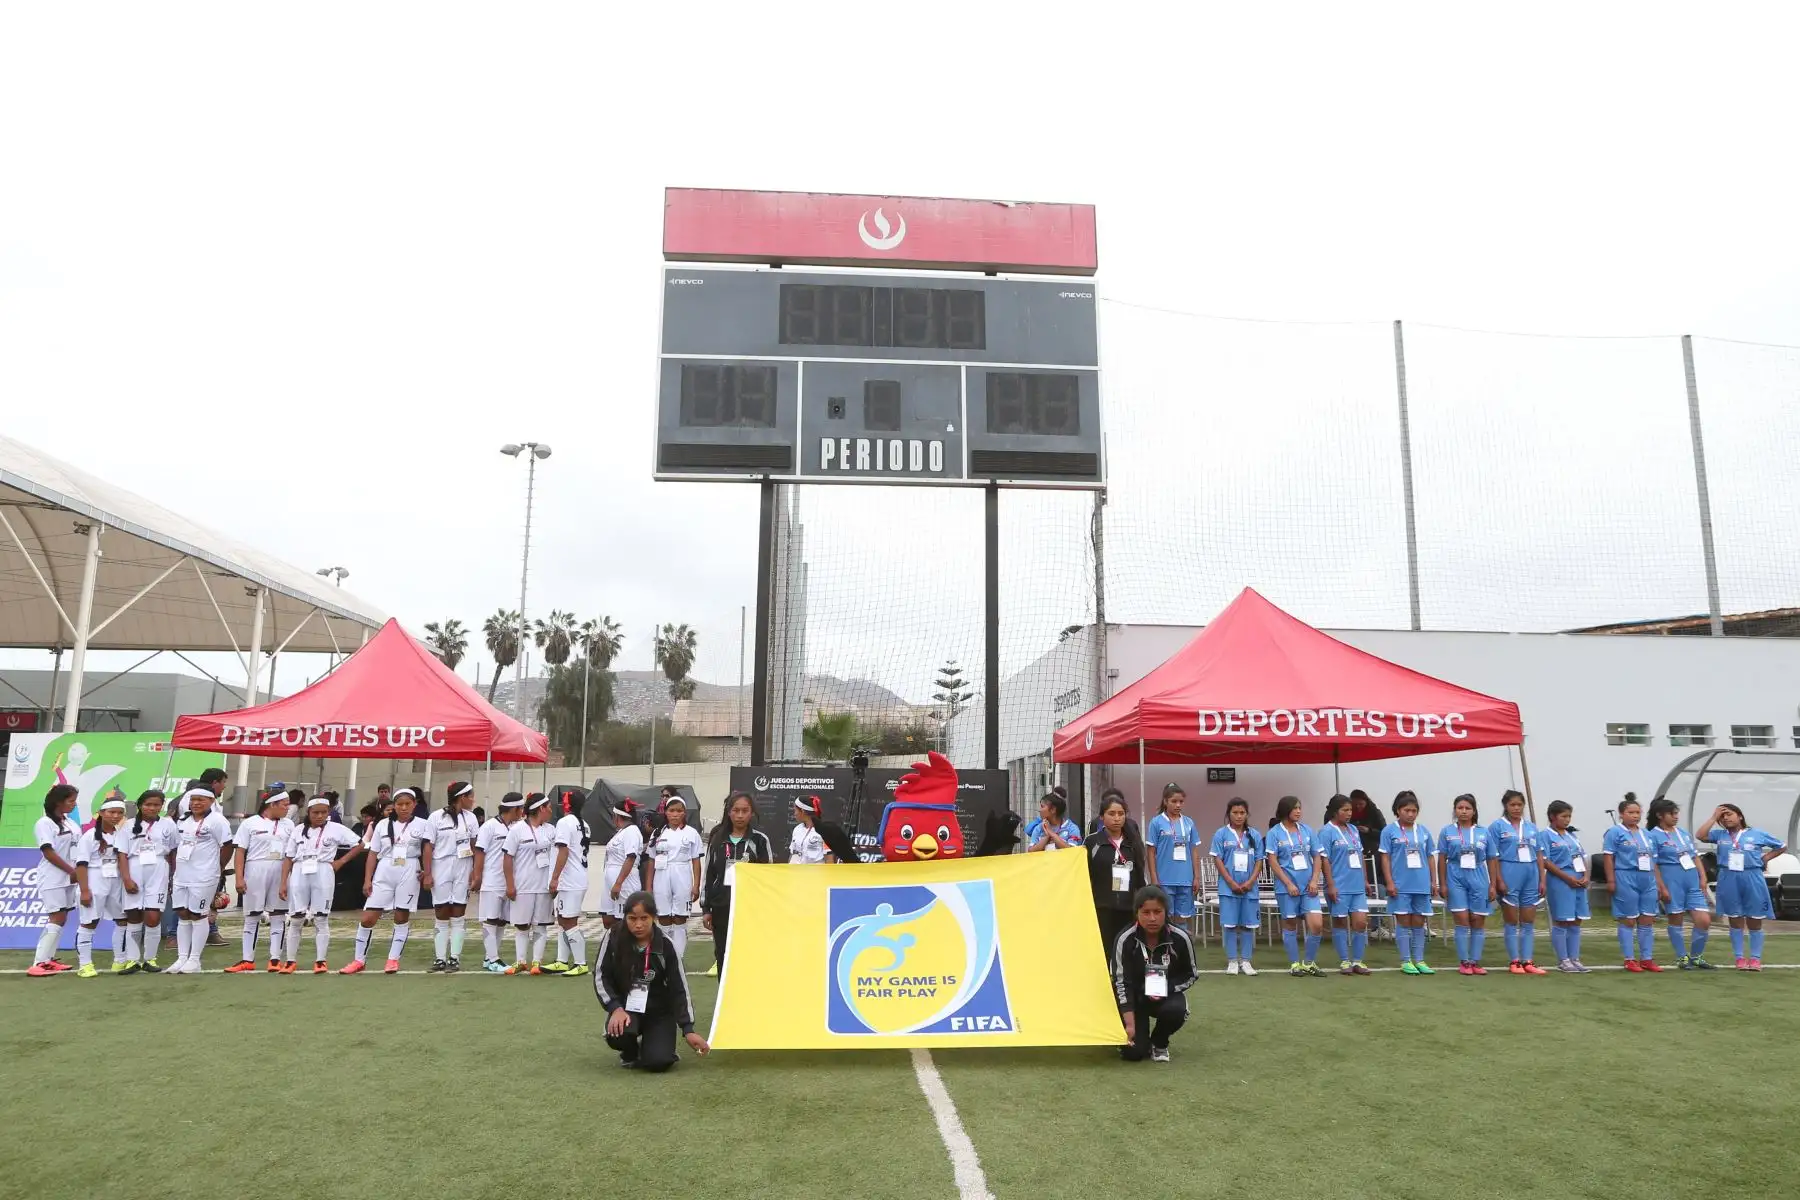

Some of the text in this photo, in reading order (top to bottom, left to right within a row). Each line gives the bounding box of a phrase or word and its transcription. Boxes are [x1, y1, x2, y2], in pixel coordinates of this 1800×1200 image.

[821, 438, 943, 472] PERIODO
[1198, 708, 1468, 739] DEPORTES UPC
[219, 724, 445, 747] DEPORTES UPC
[157, 893, 165, 904] 12
[199, 899, 206, 909] 8
[406, 894, 414, 904] 7
[857, 975, 957, 986] MY GAME IS
[857, 988, 937, 998] FAIR PLAY
[950, 1015, 1008, 1031] FIFA
